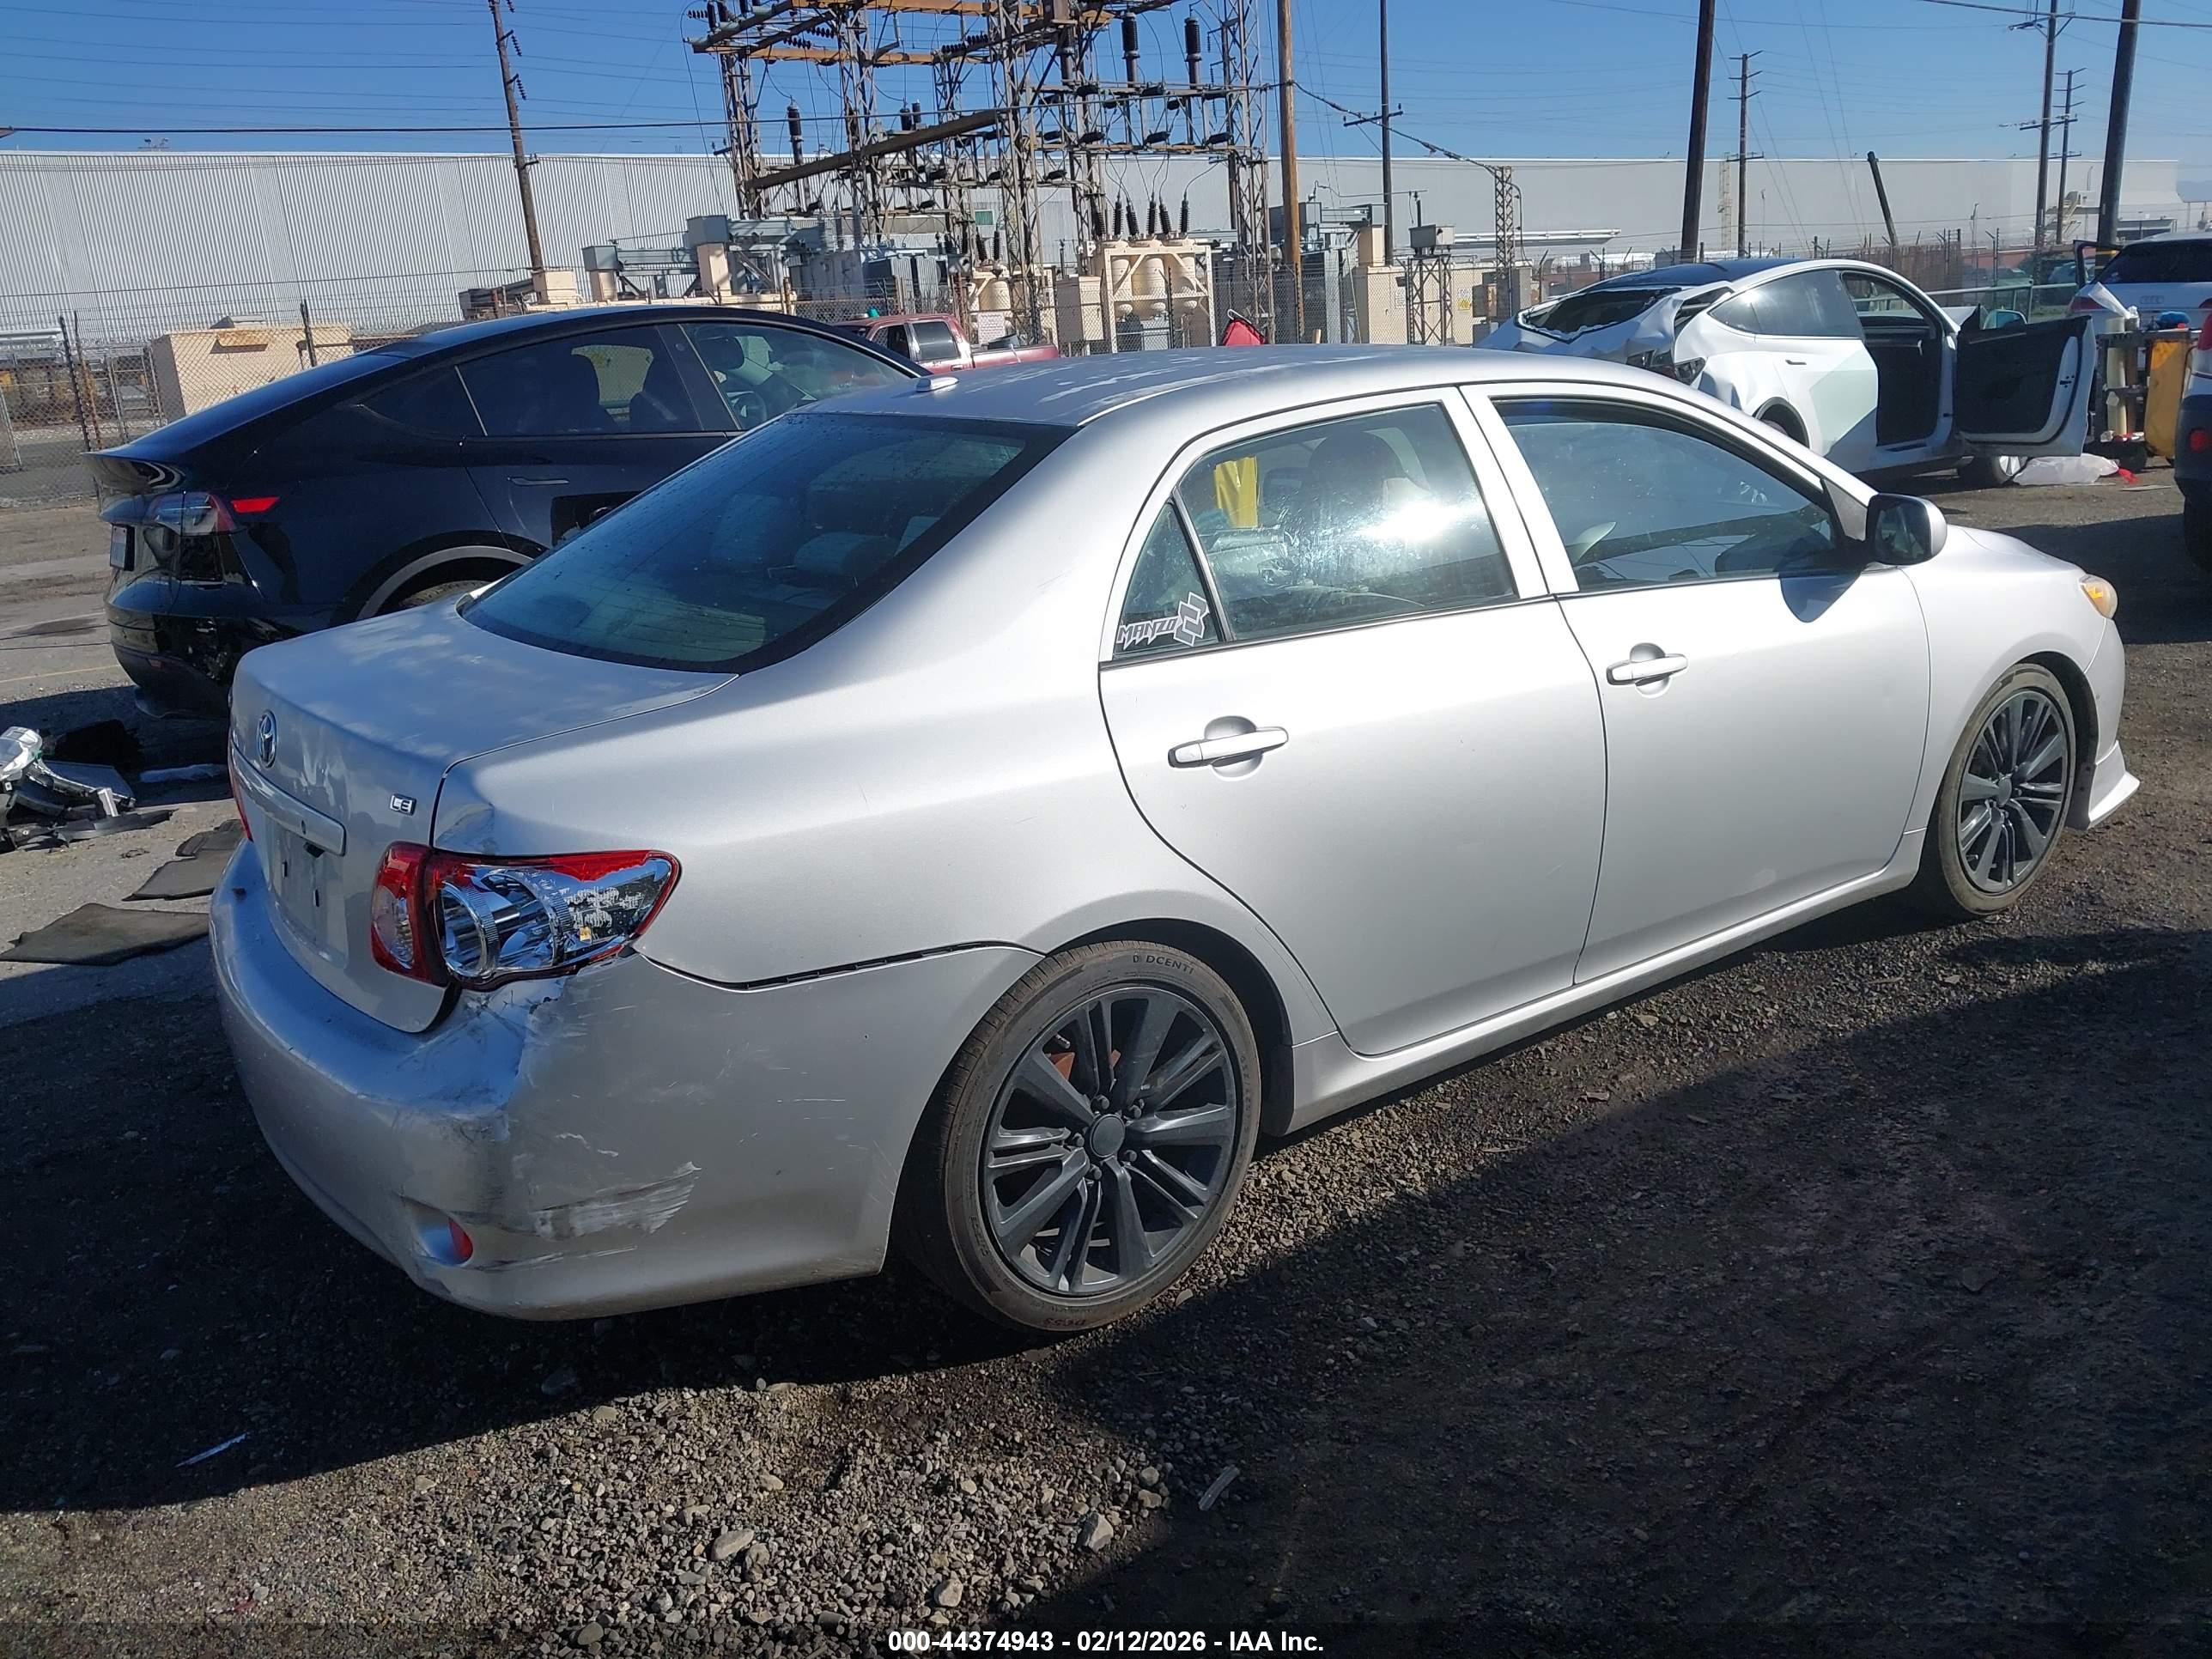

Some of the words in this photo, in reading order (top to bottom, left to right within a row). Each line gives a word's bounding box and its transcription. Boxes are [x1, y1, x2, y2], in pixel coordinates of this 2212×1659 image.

[1117, 616, 1179, 650] MANZO
[390, 794, 414, 814] LE
[1146, 954, 1194, 975] DCENTI
